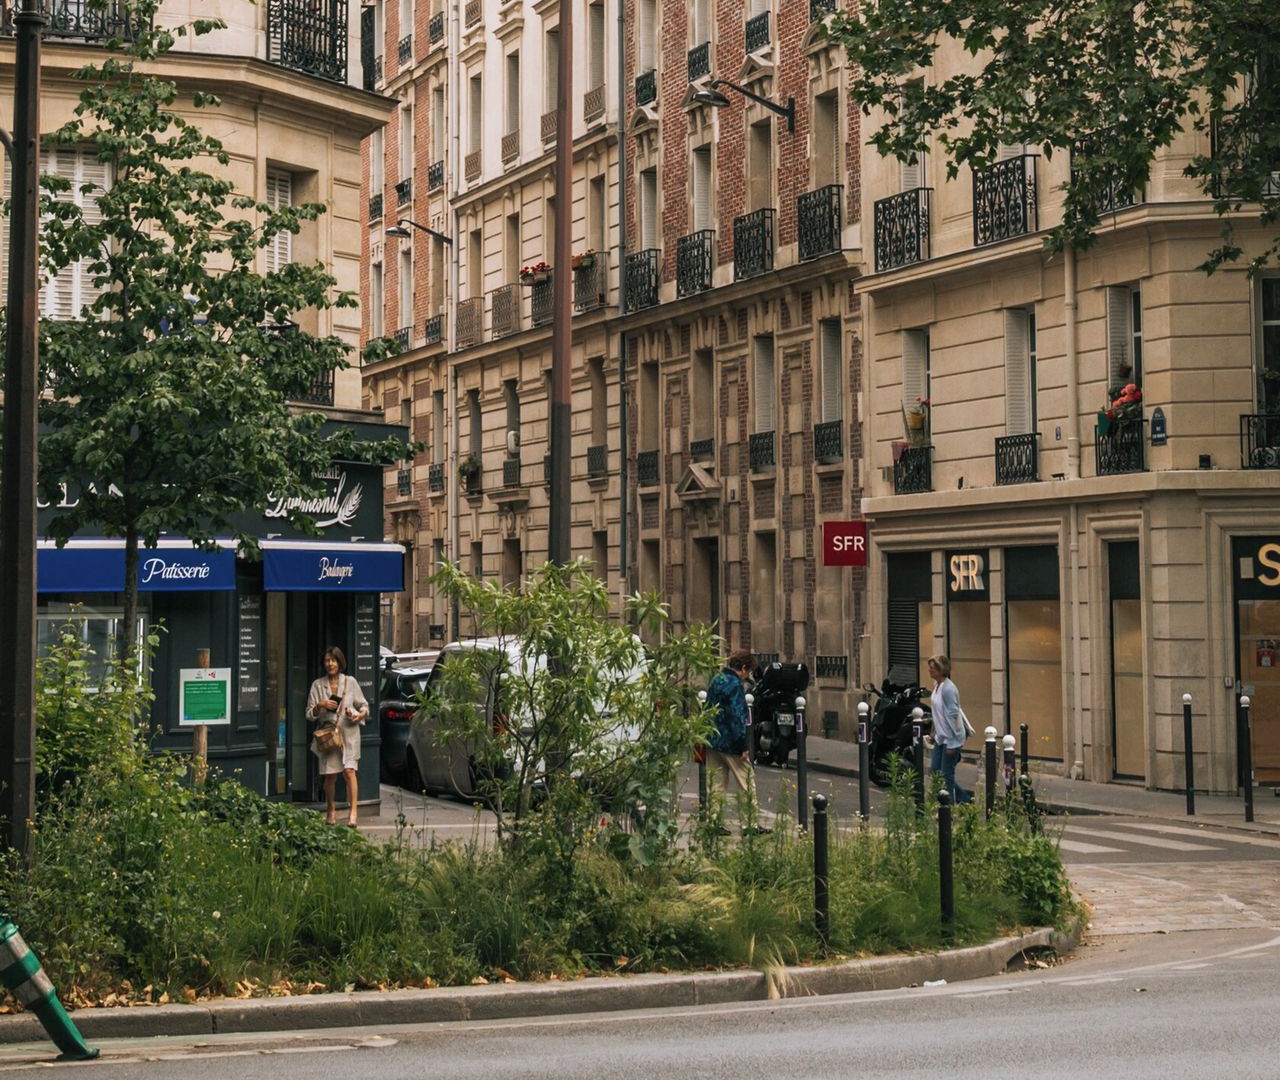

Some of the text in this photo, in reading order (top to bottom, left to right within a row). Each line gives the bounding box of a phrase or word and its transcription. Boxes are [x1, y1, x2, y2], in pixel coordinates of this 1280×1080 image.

[833, 535, 865, 552] SFR
[142, 558, 210, 584] Patisserie
[318, 557, 354, 585] Boulangerie
[950, 554, 985, 592] SFR
